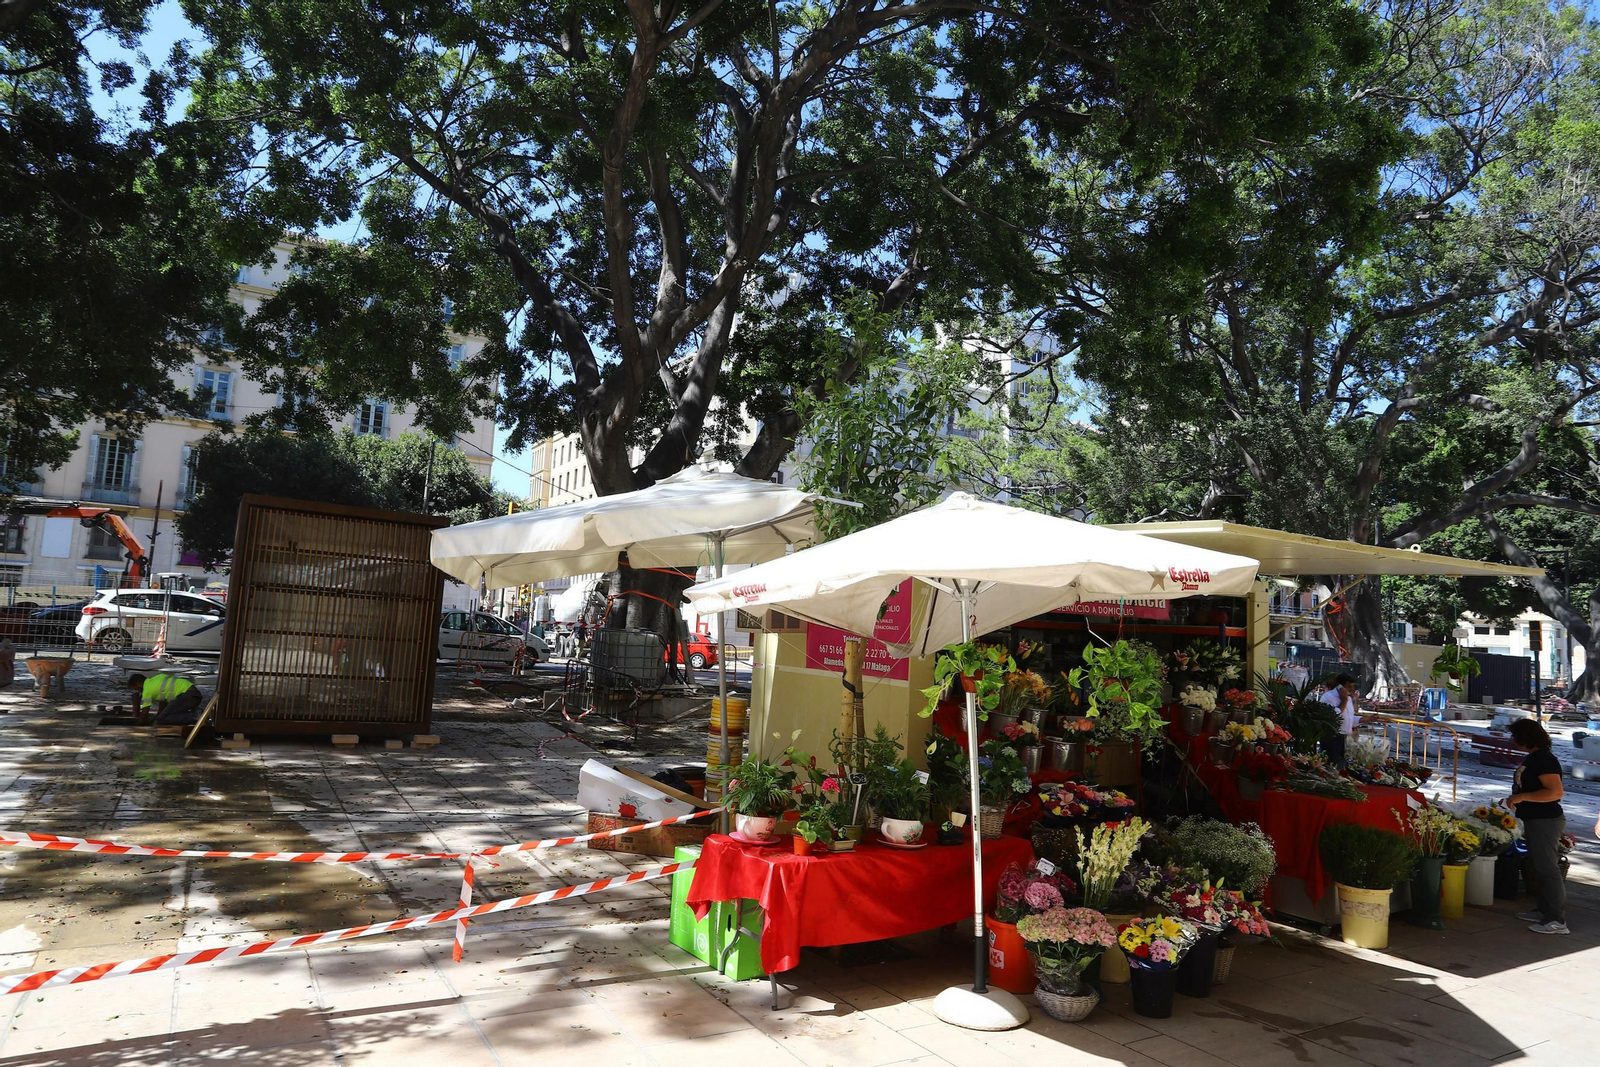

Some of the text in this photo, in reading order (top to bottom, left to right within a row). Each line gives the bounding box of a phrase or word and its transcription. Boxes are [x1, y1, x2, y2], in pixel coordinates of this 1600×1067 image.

[1168, 567, 1210, 583] Estrella
[1057, 604, 1090, 613] SERVICIO
[1098, 606, 1135, 616] DOMICLIO
